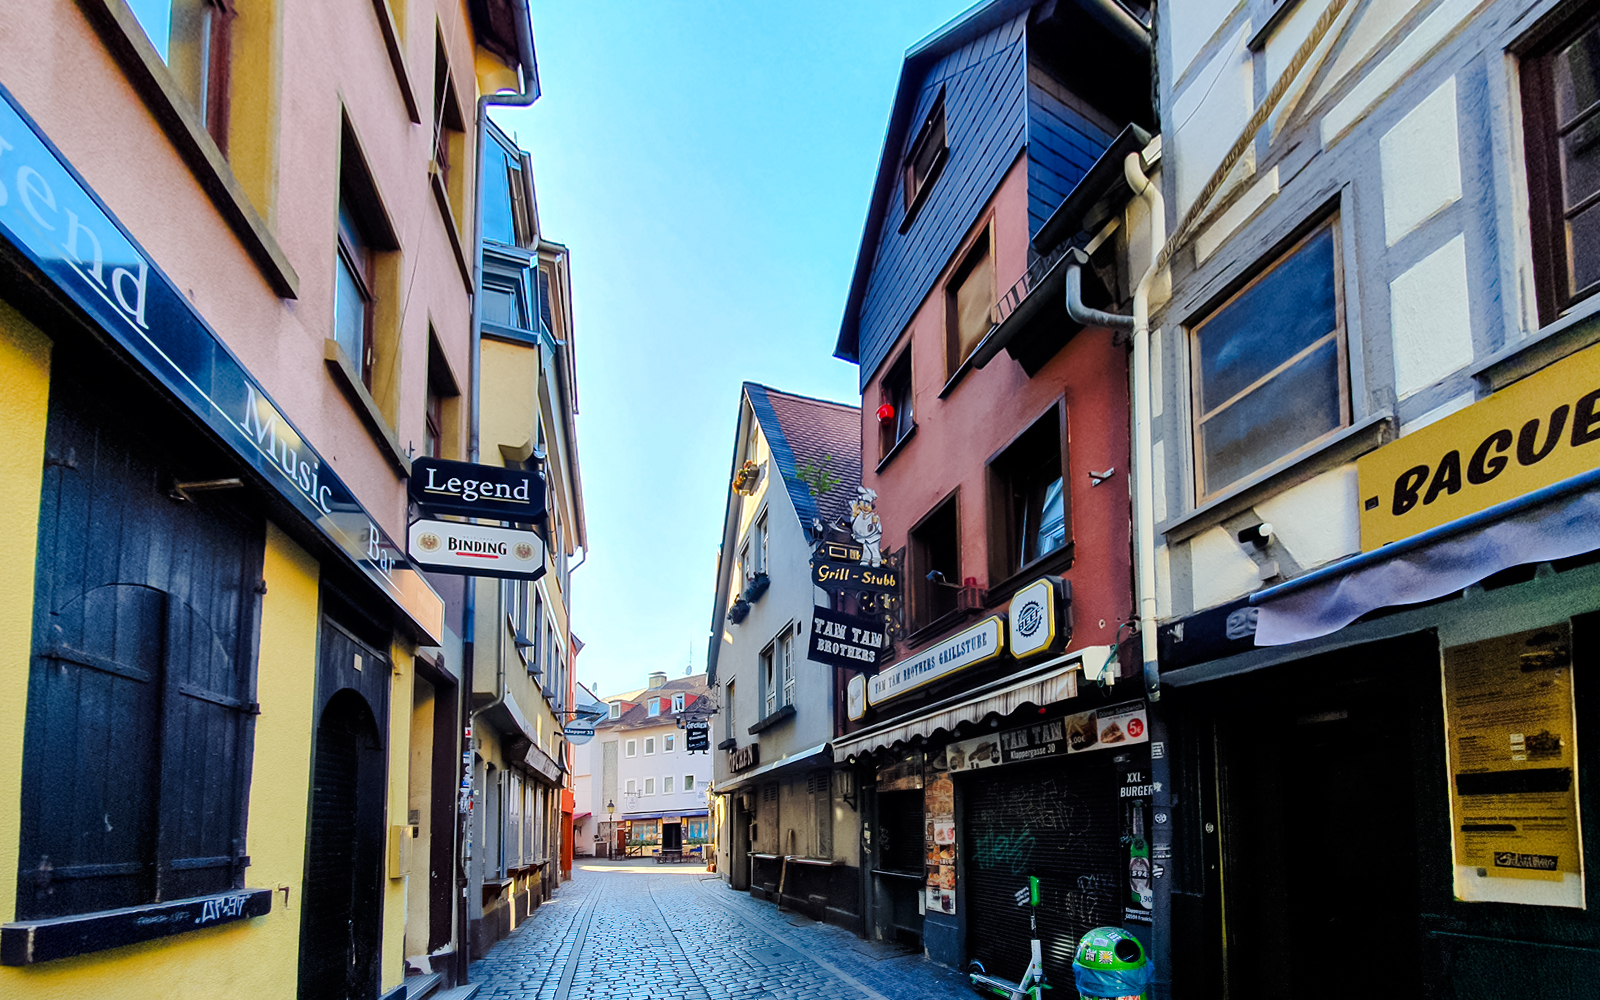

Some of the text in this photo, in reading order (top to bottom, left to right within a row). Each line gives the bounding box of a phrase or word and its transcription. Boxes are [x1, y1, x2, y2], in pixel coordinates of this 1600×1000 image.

[1391, 388, 1600, 516] BAGUE
[239, 379, 332, 514] Music
[367, 520, 396, 578] Bar
[424, 468, 530, 501] Legend
[448, 537, 507, 555] BINDING
[818, 564, 849, 582] Grill
[861, 571, 896, 587] Stubb
[814, 617, 883, 648] TAM TAM
[816, 638, 876, 663] BROTHERS
[875, 632, 988, 694] TAM TAM BROTHERS GRILLSTUBE
[1001, 721, 1064, 750] TAM TAM
[1129, 721, 1142, 734] 5€
[1010, 746, 1046, 760] Klappergasse
[1126, 772, 1146, 783] XXL-
[1120, 784, 1153, 797] BURGER
